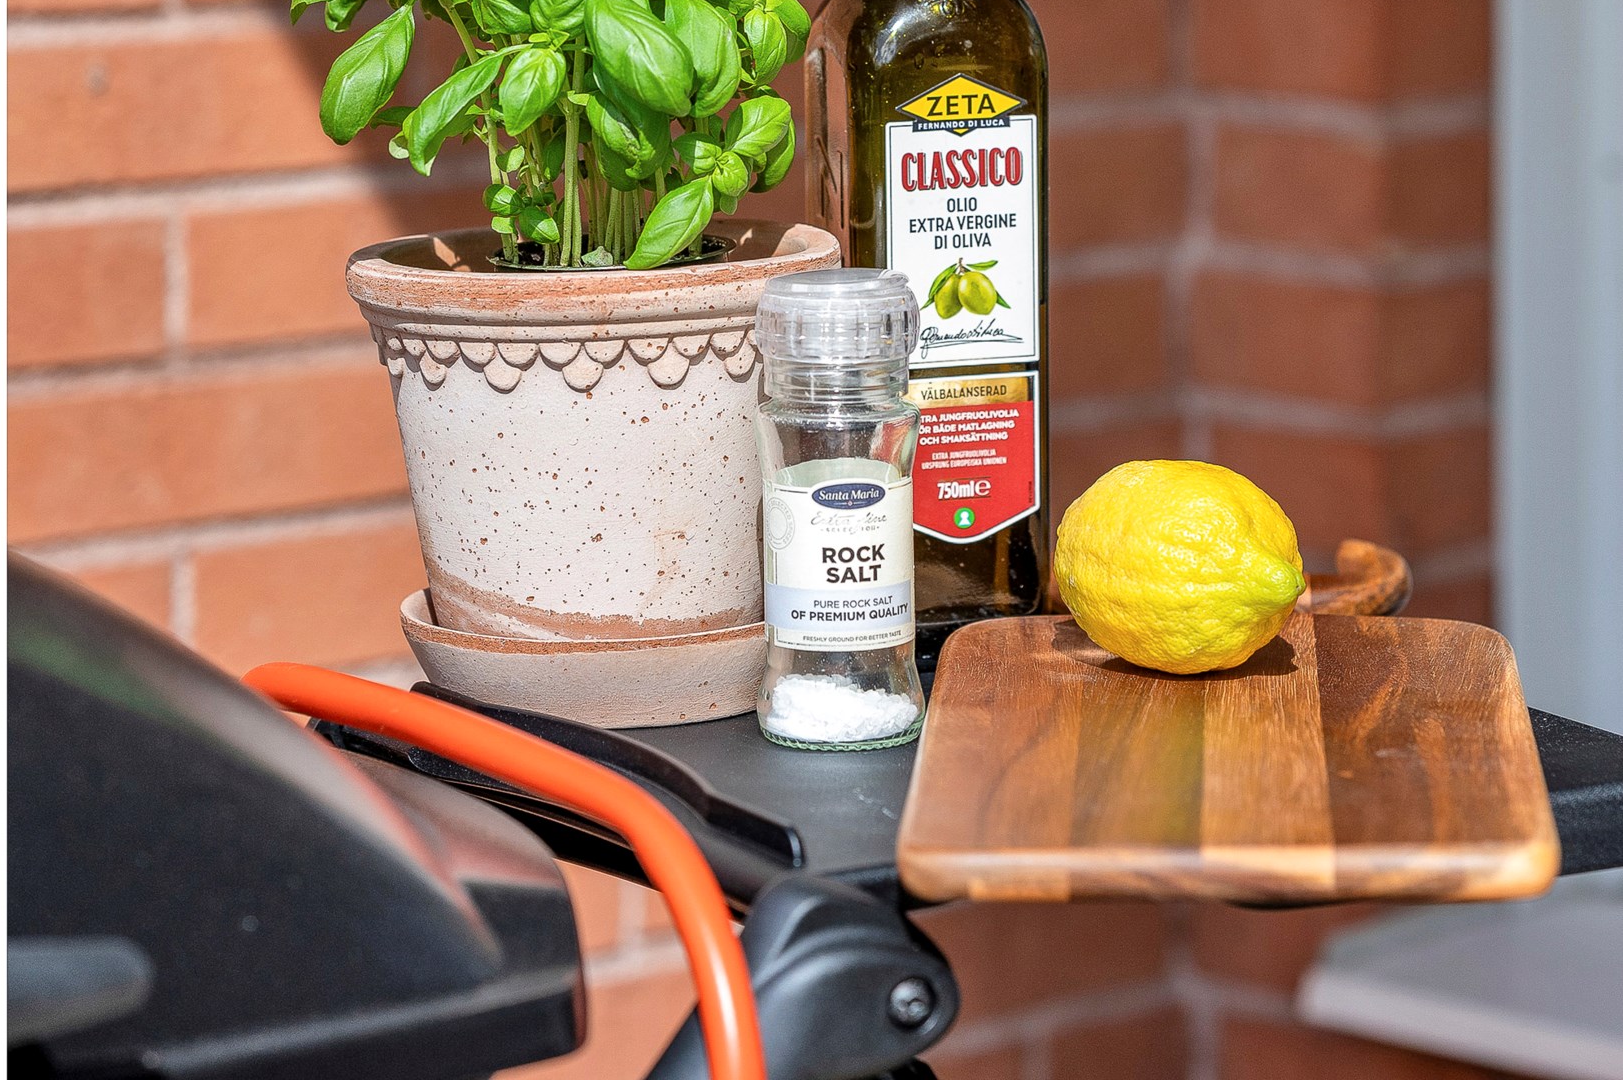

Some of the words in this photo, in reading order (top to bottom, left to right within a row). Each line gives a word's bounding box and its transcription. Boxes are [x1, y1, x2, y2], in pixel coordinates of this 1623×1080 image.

[927, 93, 996, 117] ZETA
[917, 120, 965, 130] FERNANDO
[968, 120, 977, 128] DI
[980, 119, 1005, 127] LUCA
[901, 147, 1024, 192] CLASSICO
[946, 197, 977, 213] OLIO
[909, 217, 954, 233] EXTRA
[957, 213, 1017, 230] VERGINE
[934, 235, 947, 250] DI
[952, 232, 992, 249] OLIVA
[921, 385, 1007, 401] VÄLBALANSERAD
[920, 415, 938, 423] TRA
[939, 409, 1019, 422] JUNGFRUOLIVOLJA
[919, 425, 931, 434] ÖR
[933, 423, 957, 433] BÅDE
[958, 420, 1015, 432] MATLAGNING
[919, 436, 939, 446] OCH
[940, 431, 1009, 445] SMAKSÄTTNING
[819, 489, 849, 500] Santa
[850, 488, 880, 500] Maria
[822, 543, 885, 564] ROCK
[826, 564, 881, 584] SALT
[814, 600, 839, 609] PURE
[842, 599, 871, 608] ROCK
[873, 595, 893, 606] SALT
[791, 610, 806, 620] OF
[809, 611, 865, 621] PREMIUM
[869, 603, 908, 619] QUALITY
[868, 633, 888, 641] BETTER
[889, 630, 902, 638] TASTE
